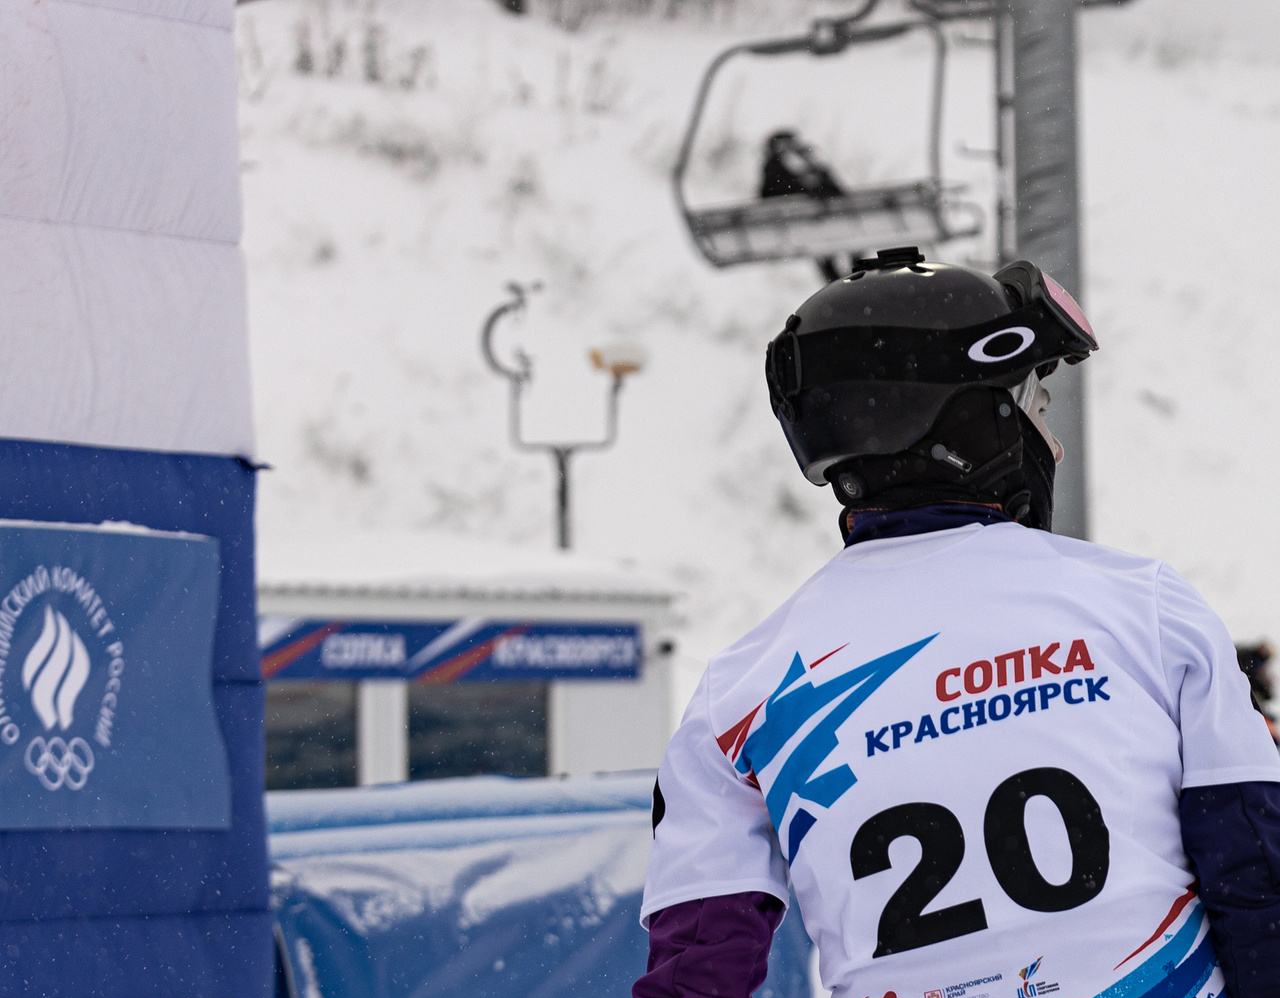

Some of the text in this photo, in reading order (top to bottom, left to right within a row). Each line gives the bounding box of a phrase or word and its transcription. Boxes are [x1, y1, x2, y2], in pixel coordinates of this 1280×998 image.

[935, 638, 1095, 702] СОПКА
[864, 675, 1111, 758] КРАСНОЯРСК
[849, 766, 1110, 960] 20
[945, 973, 1003, 993] КРАСНОЯРСКИЙ
[947, 989, 966, 998] КРАЙ
